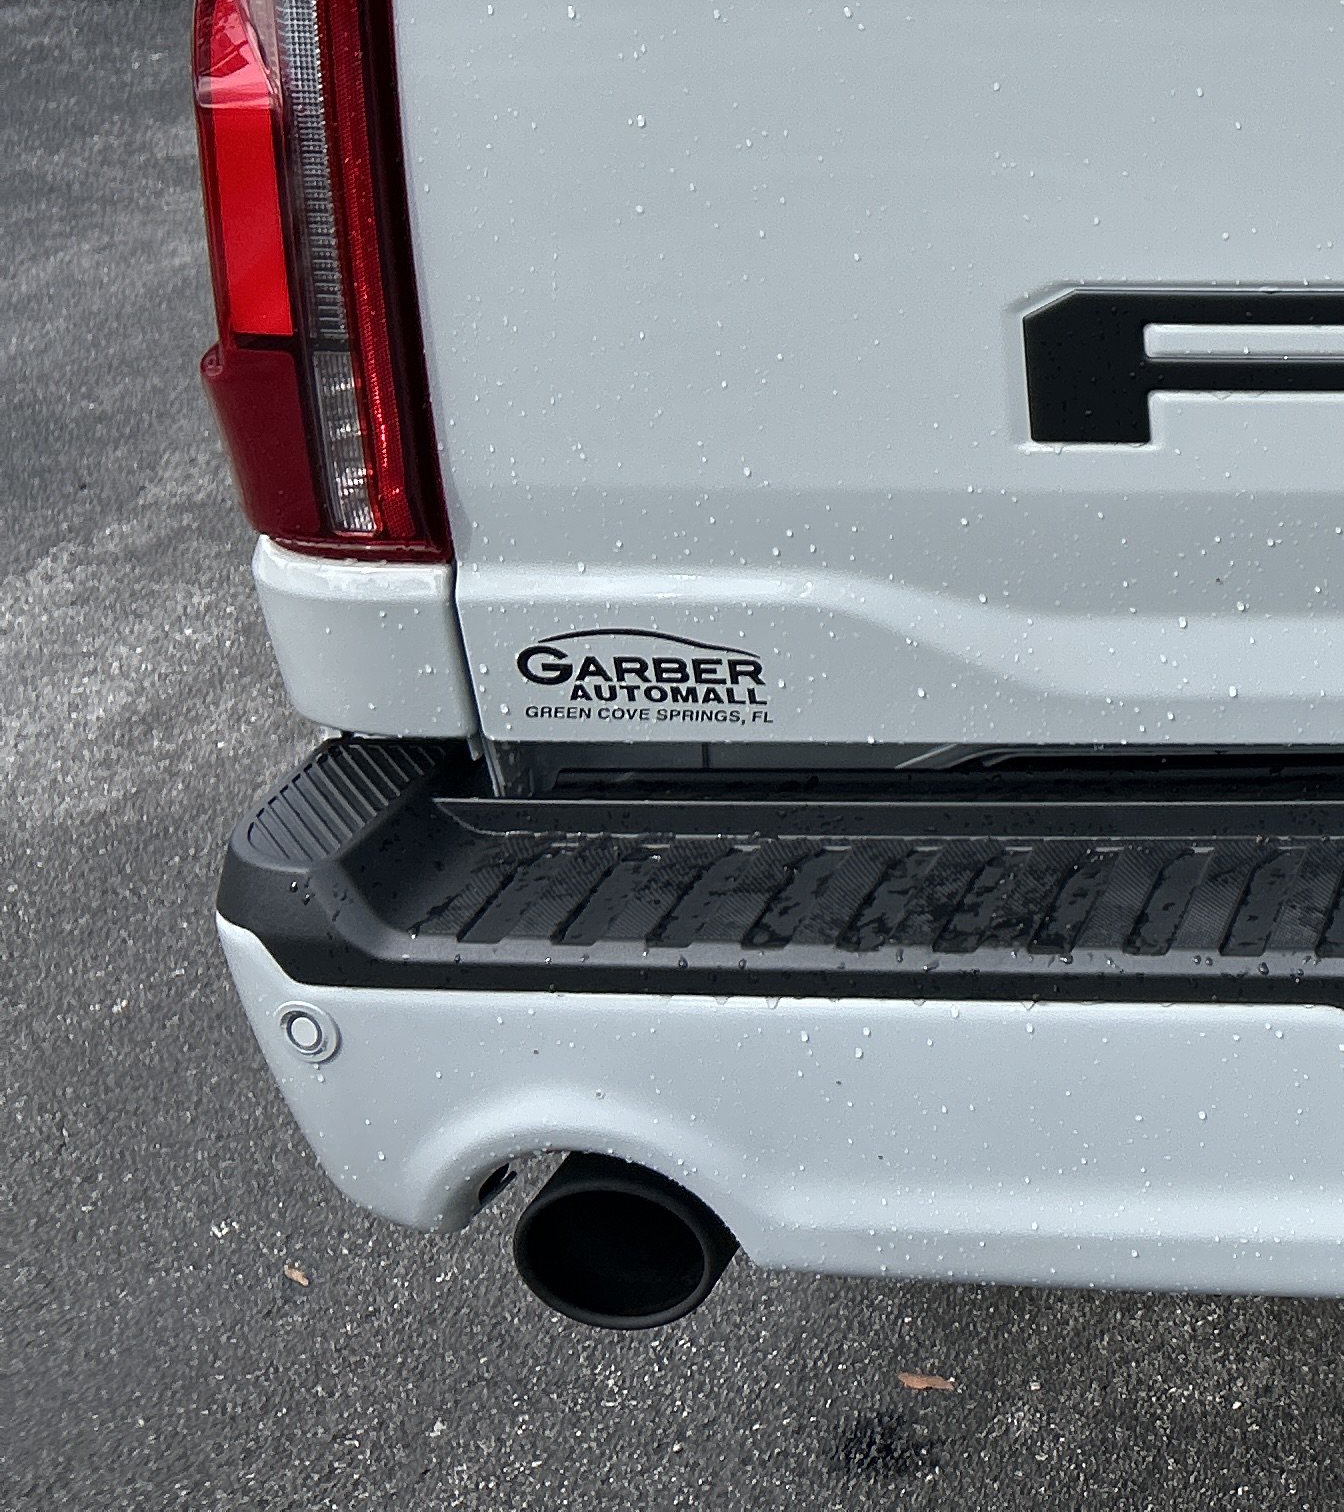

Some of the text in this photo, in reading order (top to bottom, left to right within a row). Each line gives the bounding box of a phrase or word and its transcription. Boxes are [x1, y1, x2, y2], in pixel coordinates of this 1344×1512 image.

[516, 645, 767, 686] GARBER
[569, 684, 768, 706] AUTOMALL
[525, 705, 774, 726] GREEN COVE SPRINGS, FL
